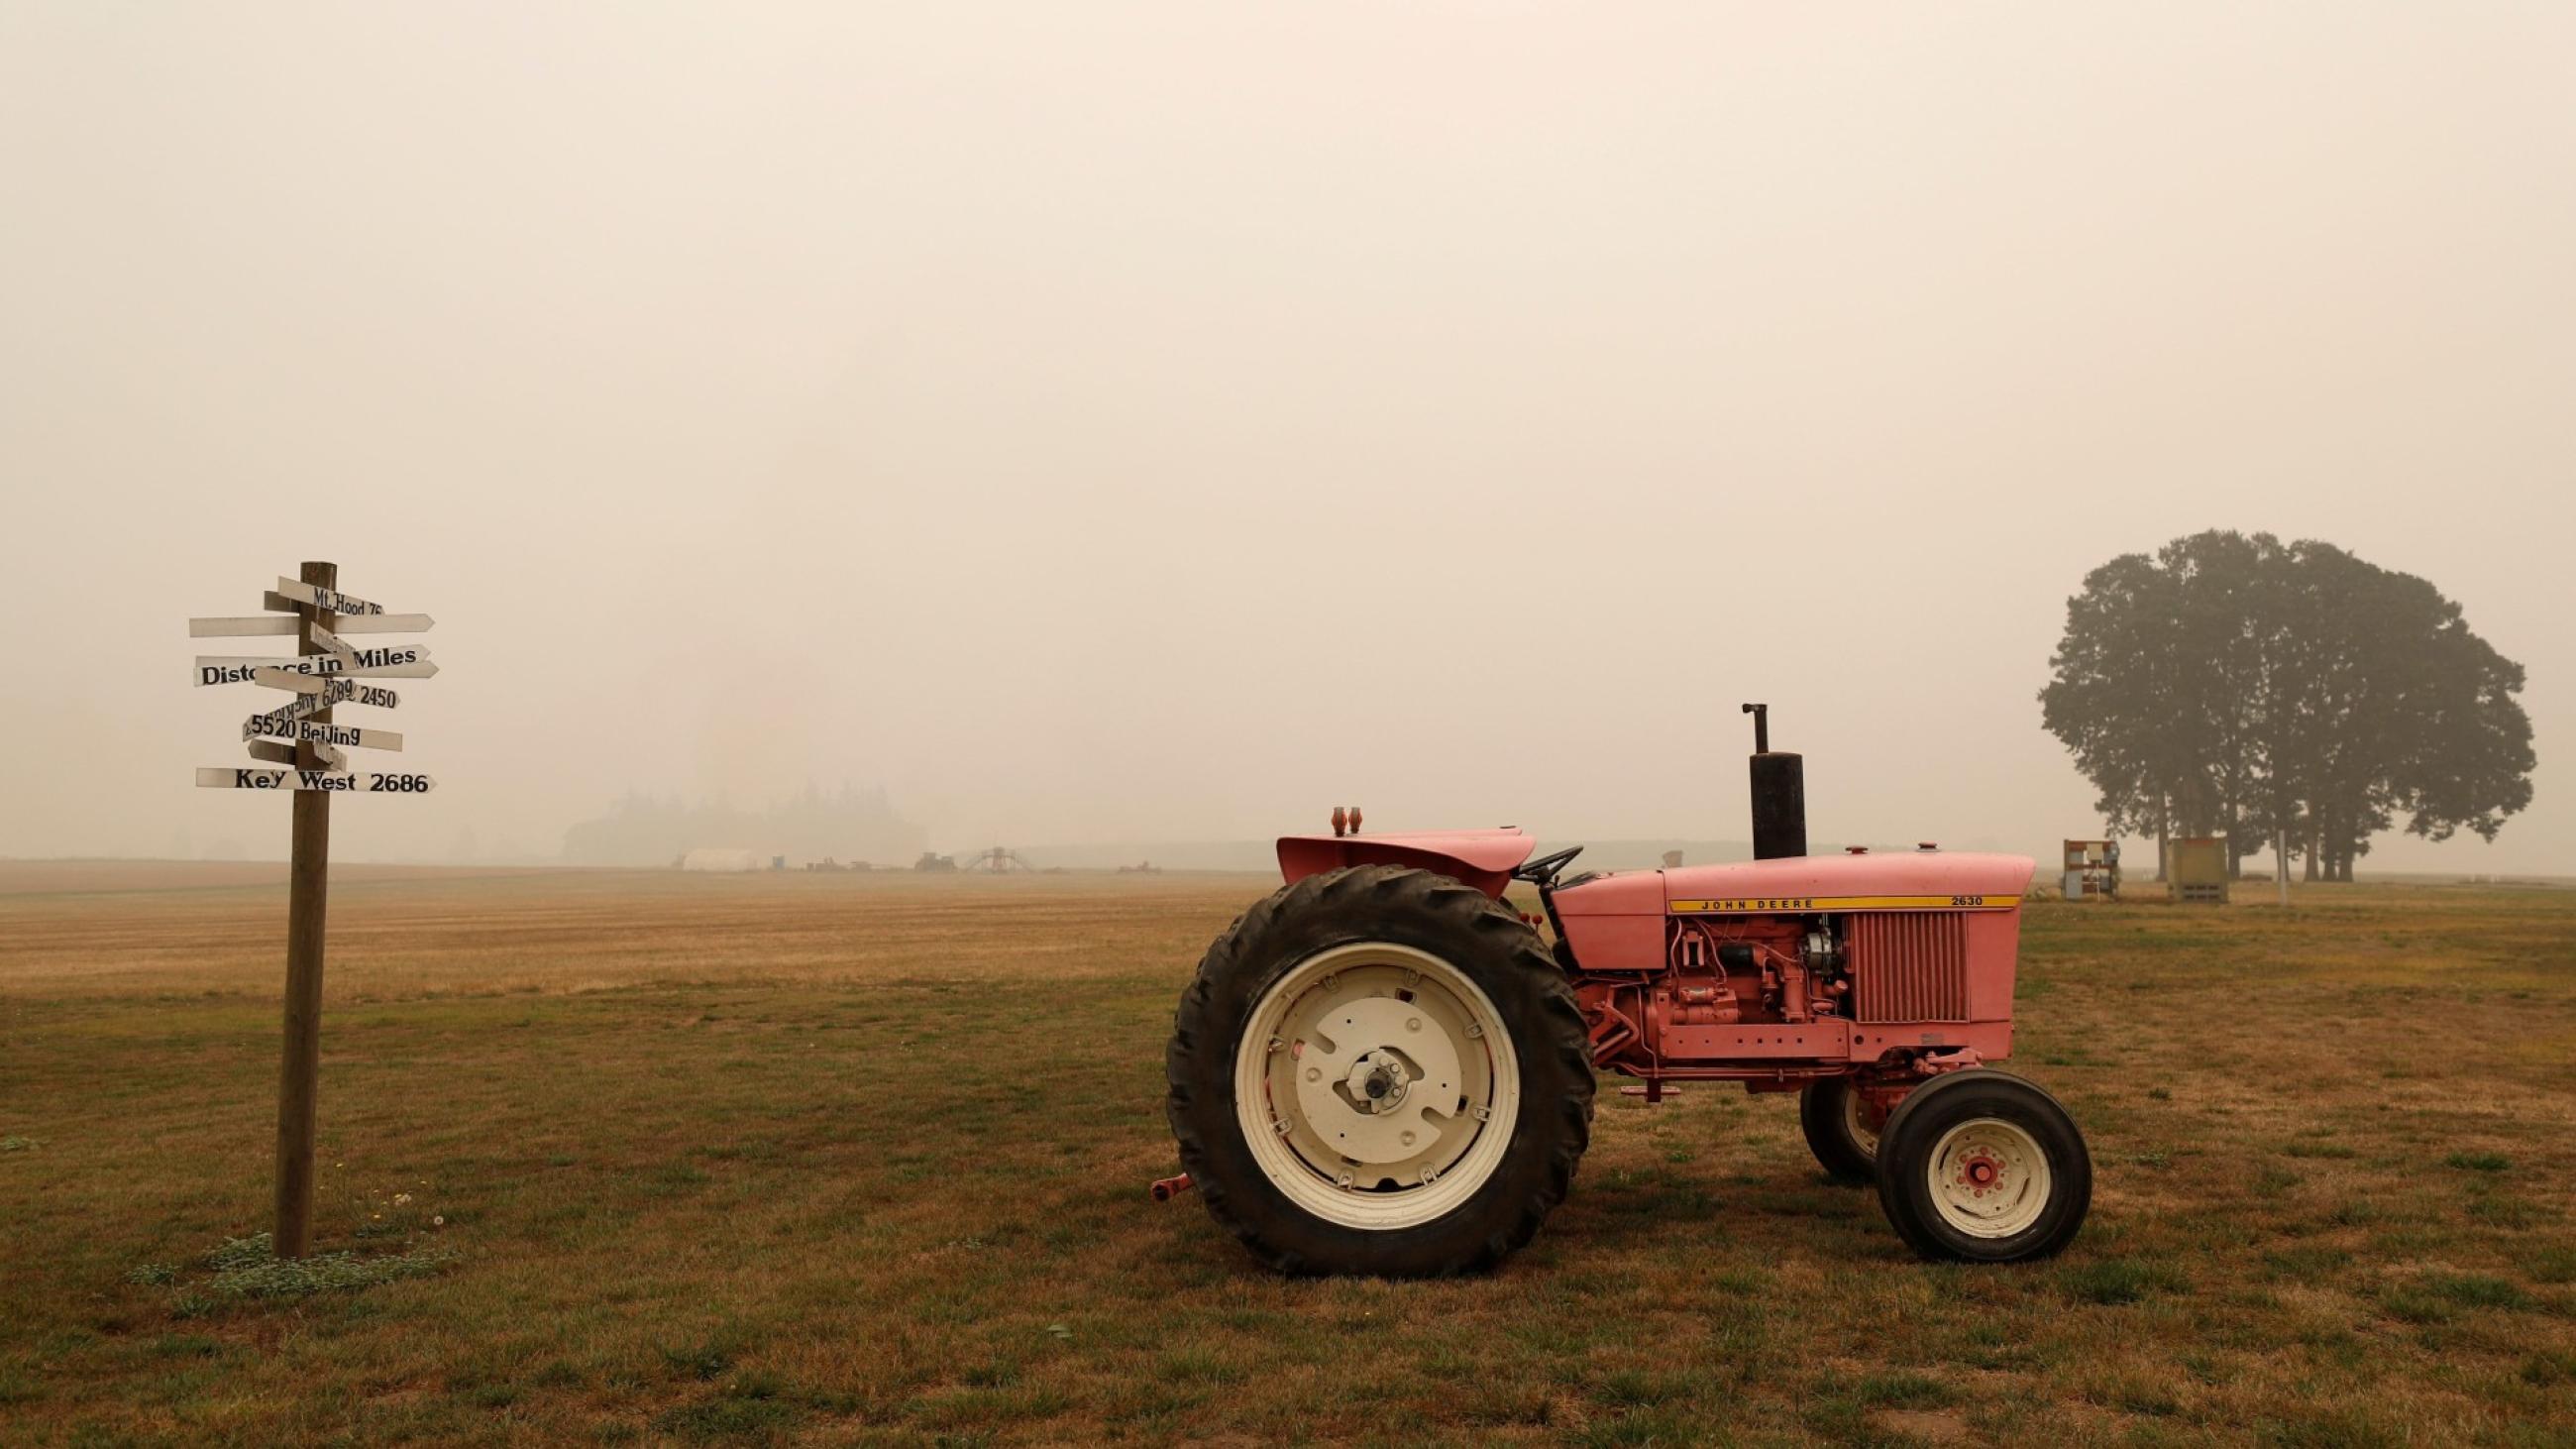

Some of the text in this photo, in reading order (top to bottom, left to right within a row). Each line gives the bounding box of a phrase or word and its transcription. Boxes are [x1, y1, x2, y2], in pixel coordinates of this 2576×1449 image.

[333, 593, 365, 615] Hood
[202, 647, 417, 685] Diste in Miles
[361, 685, 396, 709] 2450
[252, 715, 296, 739] 5520
[235, 768, 429, 793] Key West 2686
[1702, 900, 1813, 910] JOHN DEERE
[1951, 896, 1983, 906] 2630
